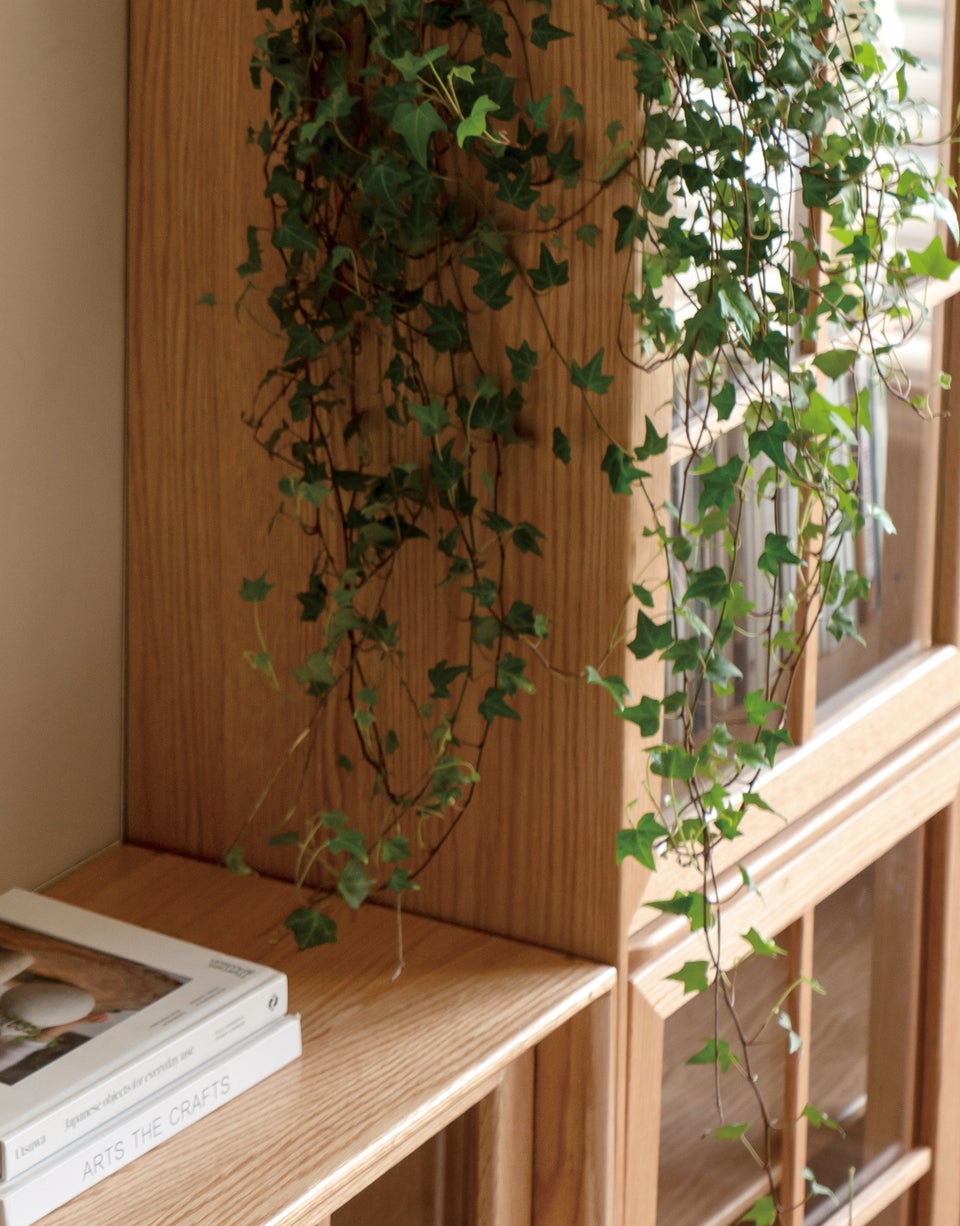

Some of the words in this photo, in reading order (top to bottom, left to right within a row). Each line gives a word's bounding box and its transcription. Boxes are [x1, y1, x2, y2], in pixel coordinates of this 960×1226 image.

[82, 1140, 125, 1181] ARTS
[131, 1116, 162, 1148] THE
[168, 1075, 231, 1126] CRAFTS
